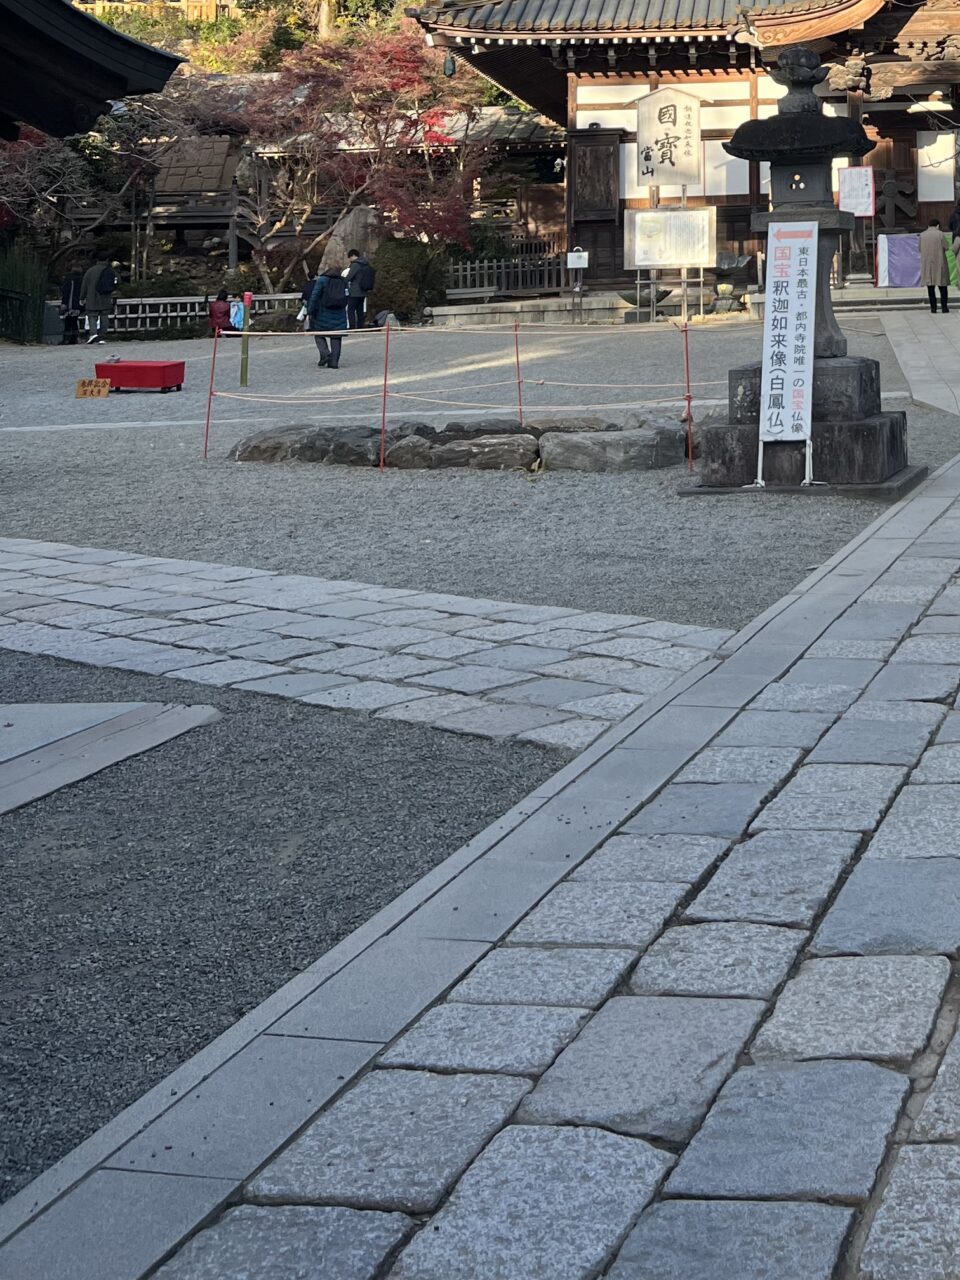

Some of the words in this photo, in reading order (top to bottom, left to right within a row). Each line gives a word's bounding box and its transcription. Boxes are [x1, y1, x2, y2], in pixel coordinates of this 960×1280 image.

[766, 246, 792, 435] 国宝釈迦如来像(白鳳仏)
